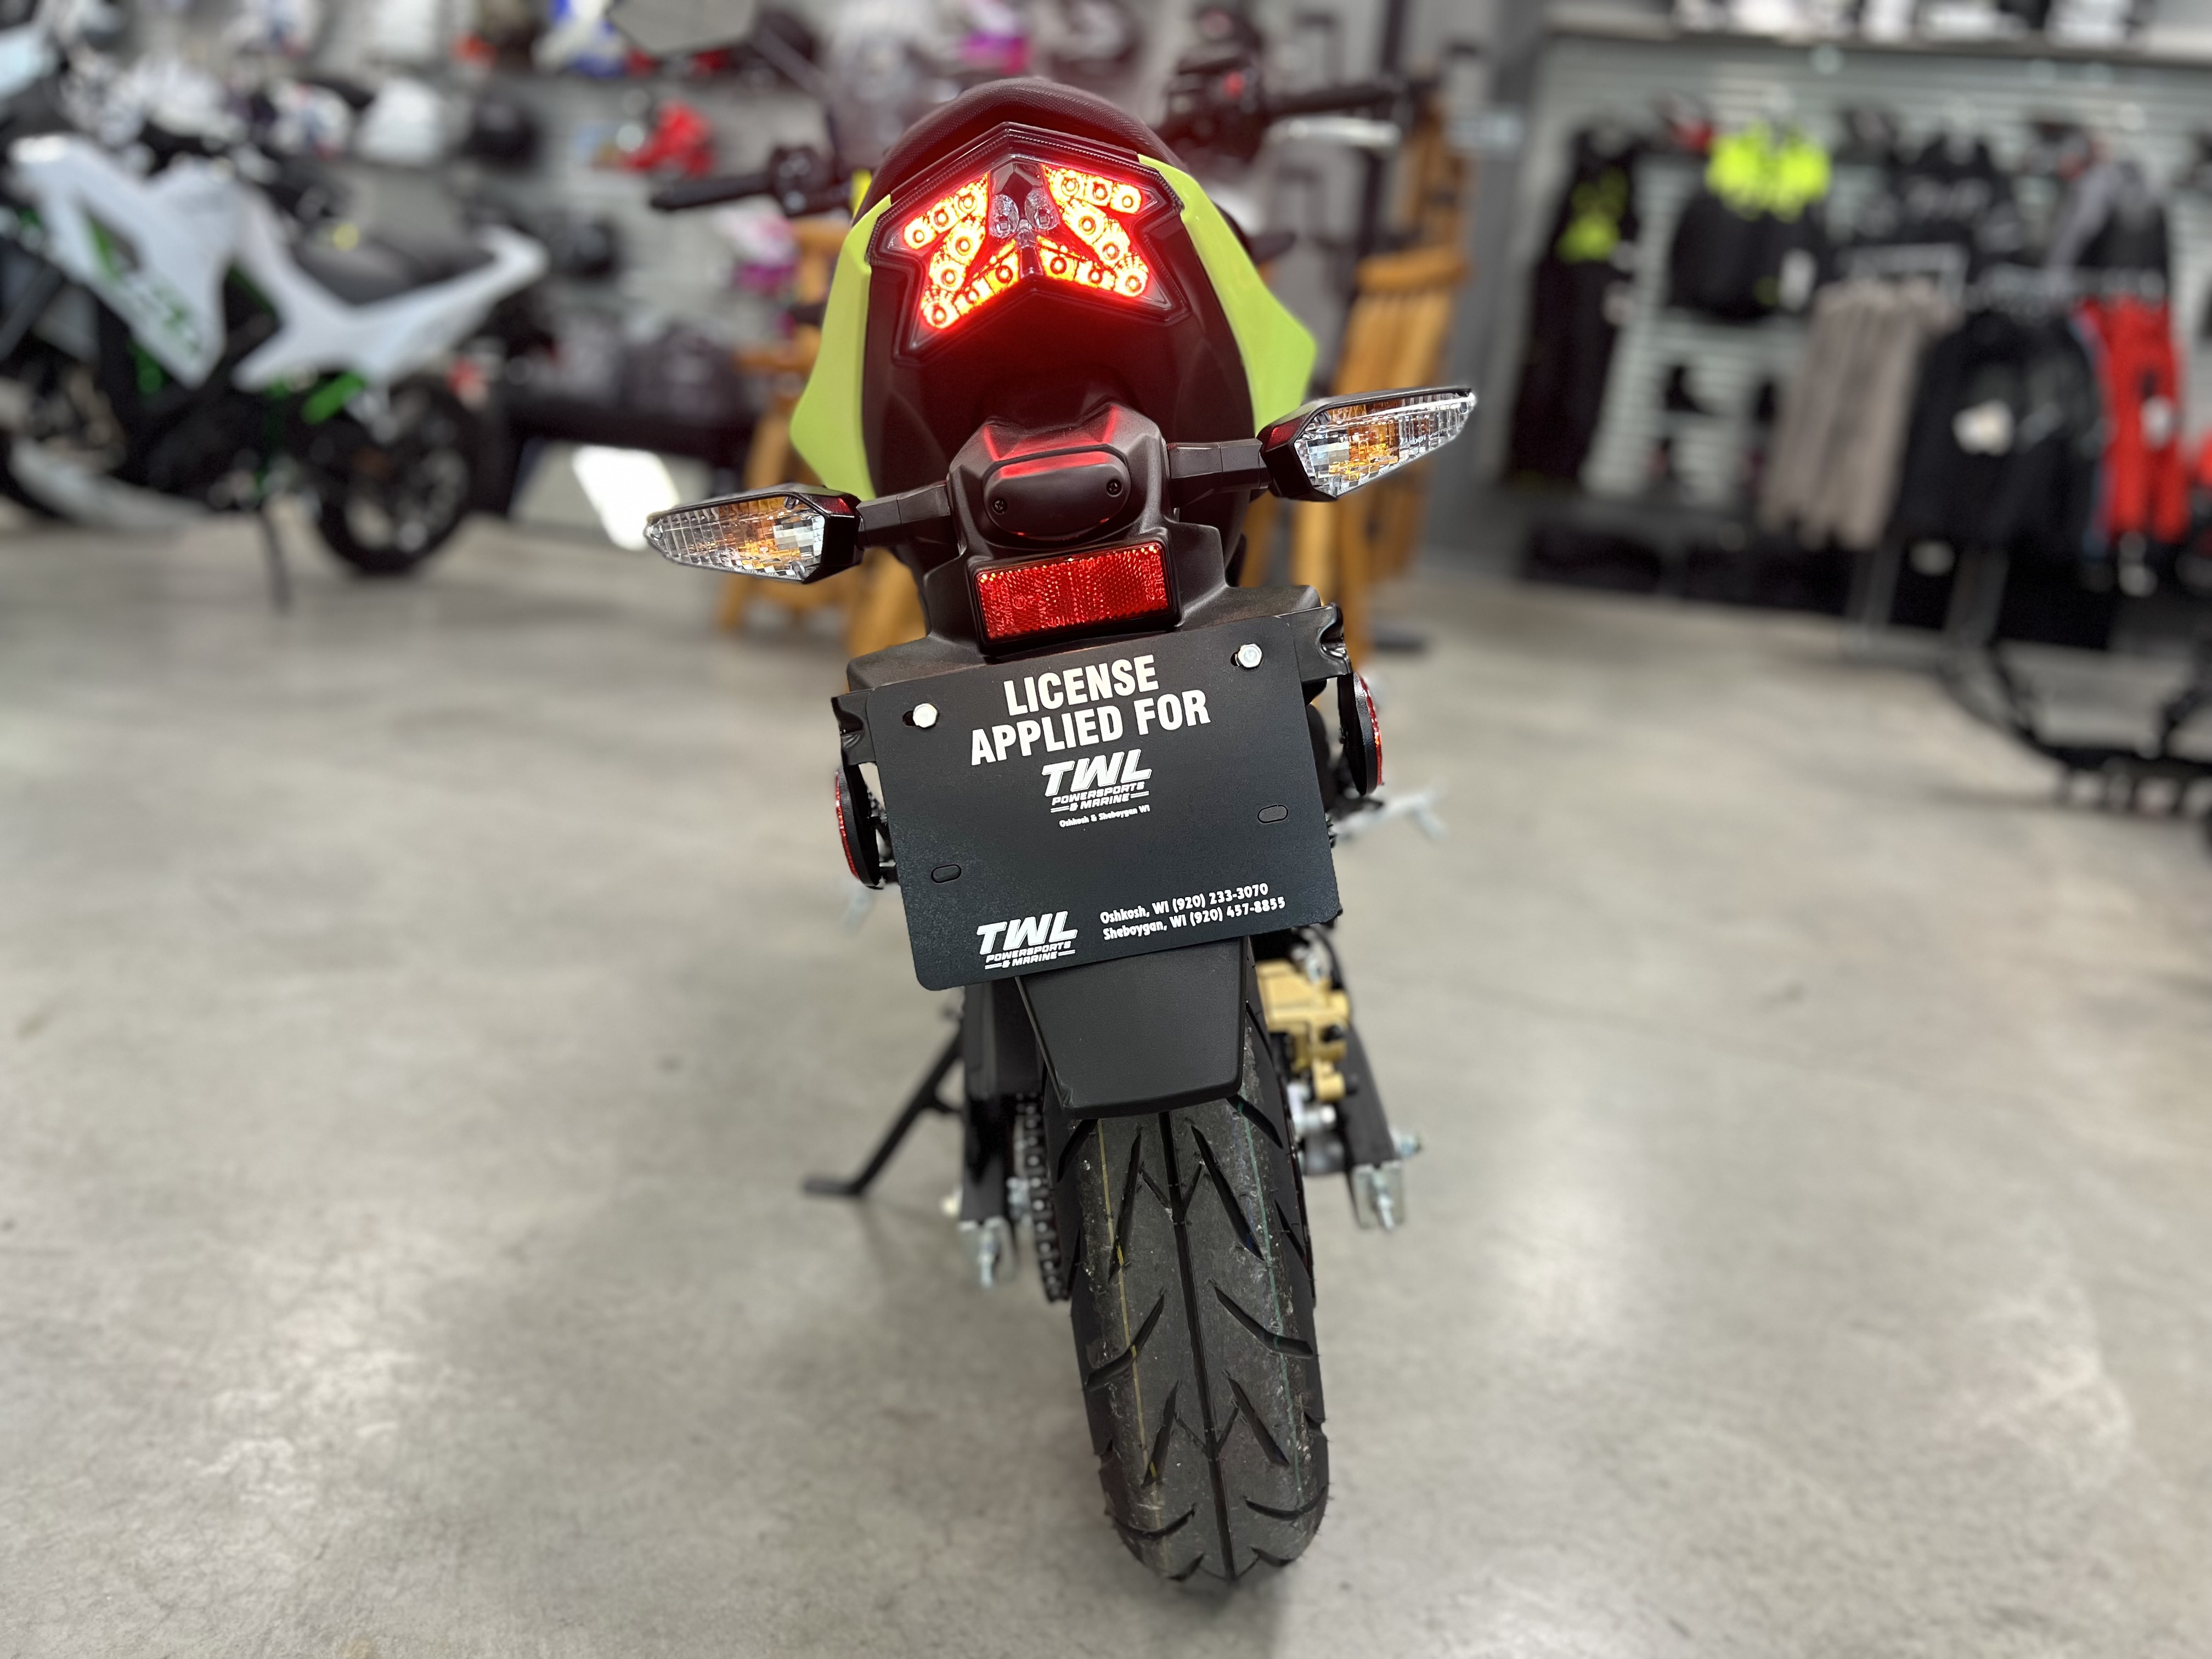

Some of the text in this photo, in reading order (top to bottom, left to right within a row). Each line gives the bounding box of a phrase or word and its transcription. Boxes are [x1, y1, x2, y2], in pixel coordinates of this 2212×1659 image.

[1003, 654, 1159, 716] LICENSE
[971, 690, 1211, 766] APPLIED FOR
[1041, 748, 1153, 797] TWL
[1051, 781, 1145, 806] POWERSPORTS
[1069, 792, 1130, 811] & MARINE
[1059, 815, 1090, 828] Oshkosh
[1098, 808, 1138, 821] Sheboygan
[1138, 804, 1150, 813] WI
[1100, 883, 1268, 924] Oshkosh, WI (920) 233-3070
[1103, 896, 1285, 940] Sheboygan, WI (920) 457-8855
[976, 911, 1078, 955] TWL
[985, 940, 1071, 963] POWERSPORTS
[1002, 951, 1058, 968] & MARINE
